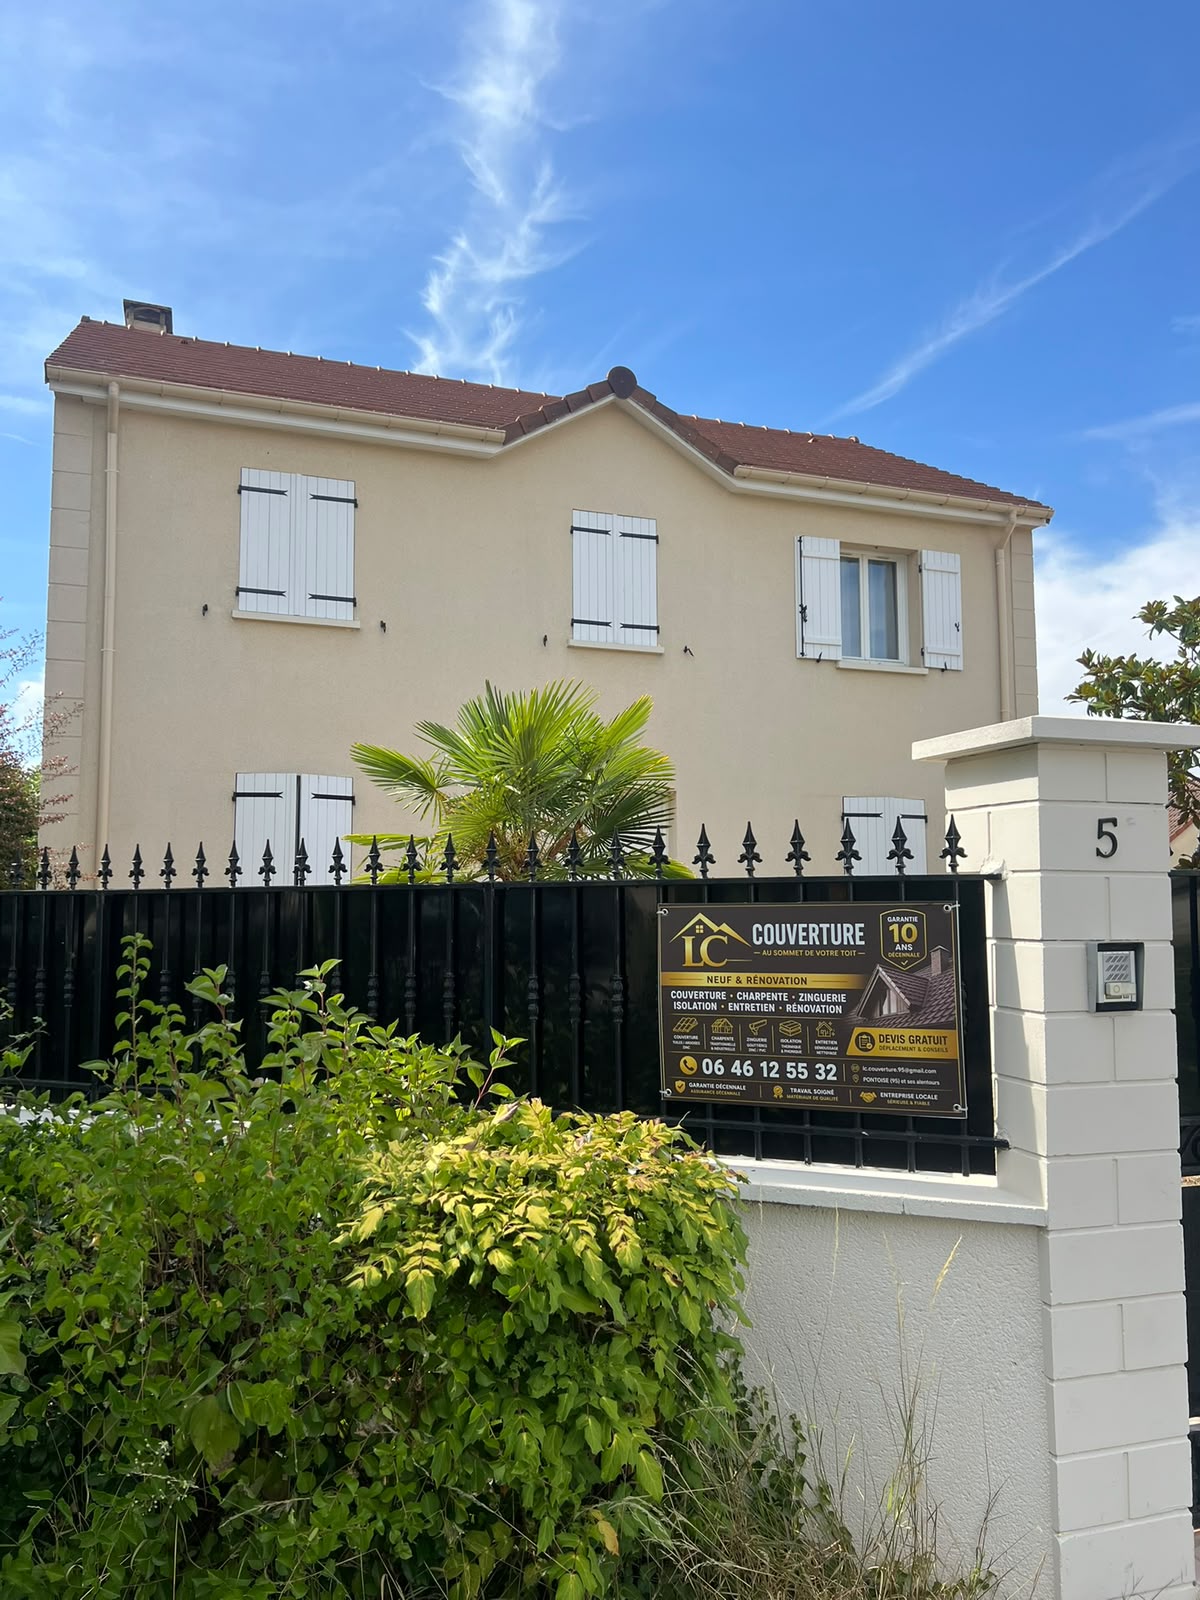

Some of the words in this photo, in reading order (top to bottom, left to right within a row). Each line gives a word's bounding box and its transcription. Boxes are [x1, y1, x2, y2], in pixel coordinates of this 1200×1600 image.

[1096, 817, 1118, 858] 5
[752, 924, 865, 945] COUVERTURE
[888, 923, 918, 943] 10
[746, 975, 808, 985] RÉNOVATION
[670, 990, 726, 1000] COUVERTURE
[736, 992, 788, 1001] CHARPENTE
[799, 993, 846, 1002] ZINGUERIE
[674, 1002, 717, 1010] ISOLATION
[728, 1003, 775, 1012] ENTRETIEN
[786, 1002, 842, 1014] RÉNOVATION
[878, 1034, 905, 1044] DEVIS
[908, 1035, 948, 1045] GRATUIT
[702, 1058, 725, 1075] 06
[731, 1060, 754, 1077] 46
[760, 1061, 780, 1078] 12
[786, 1062, 808, 1079] 55
[815, 1064, 837, 1081] 32
